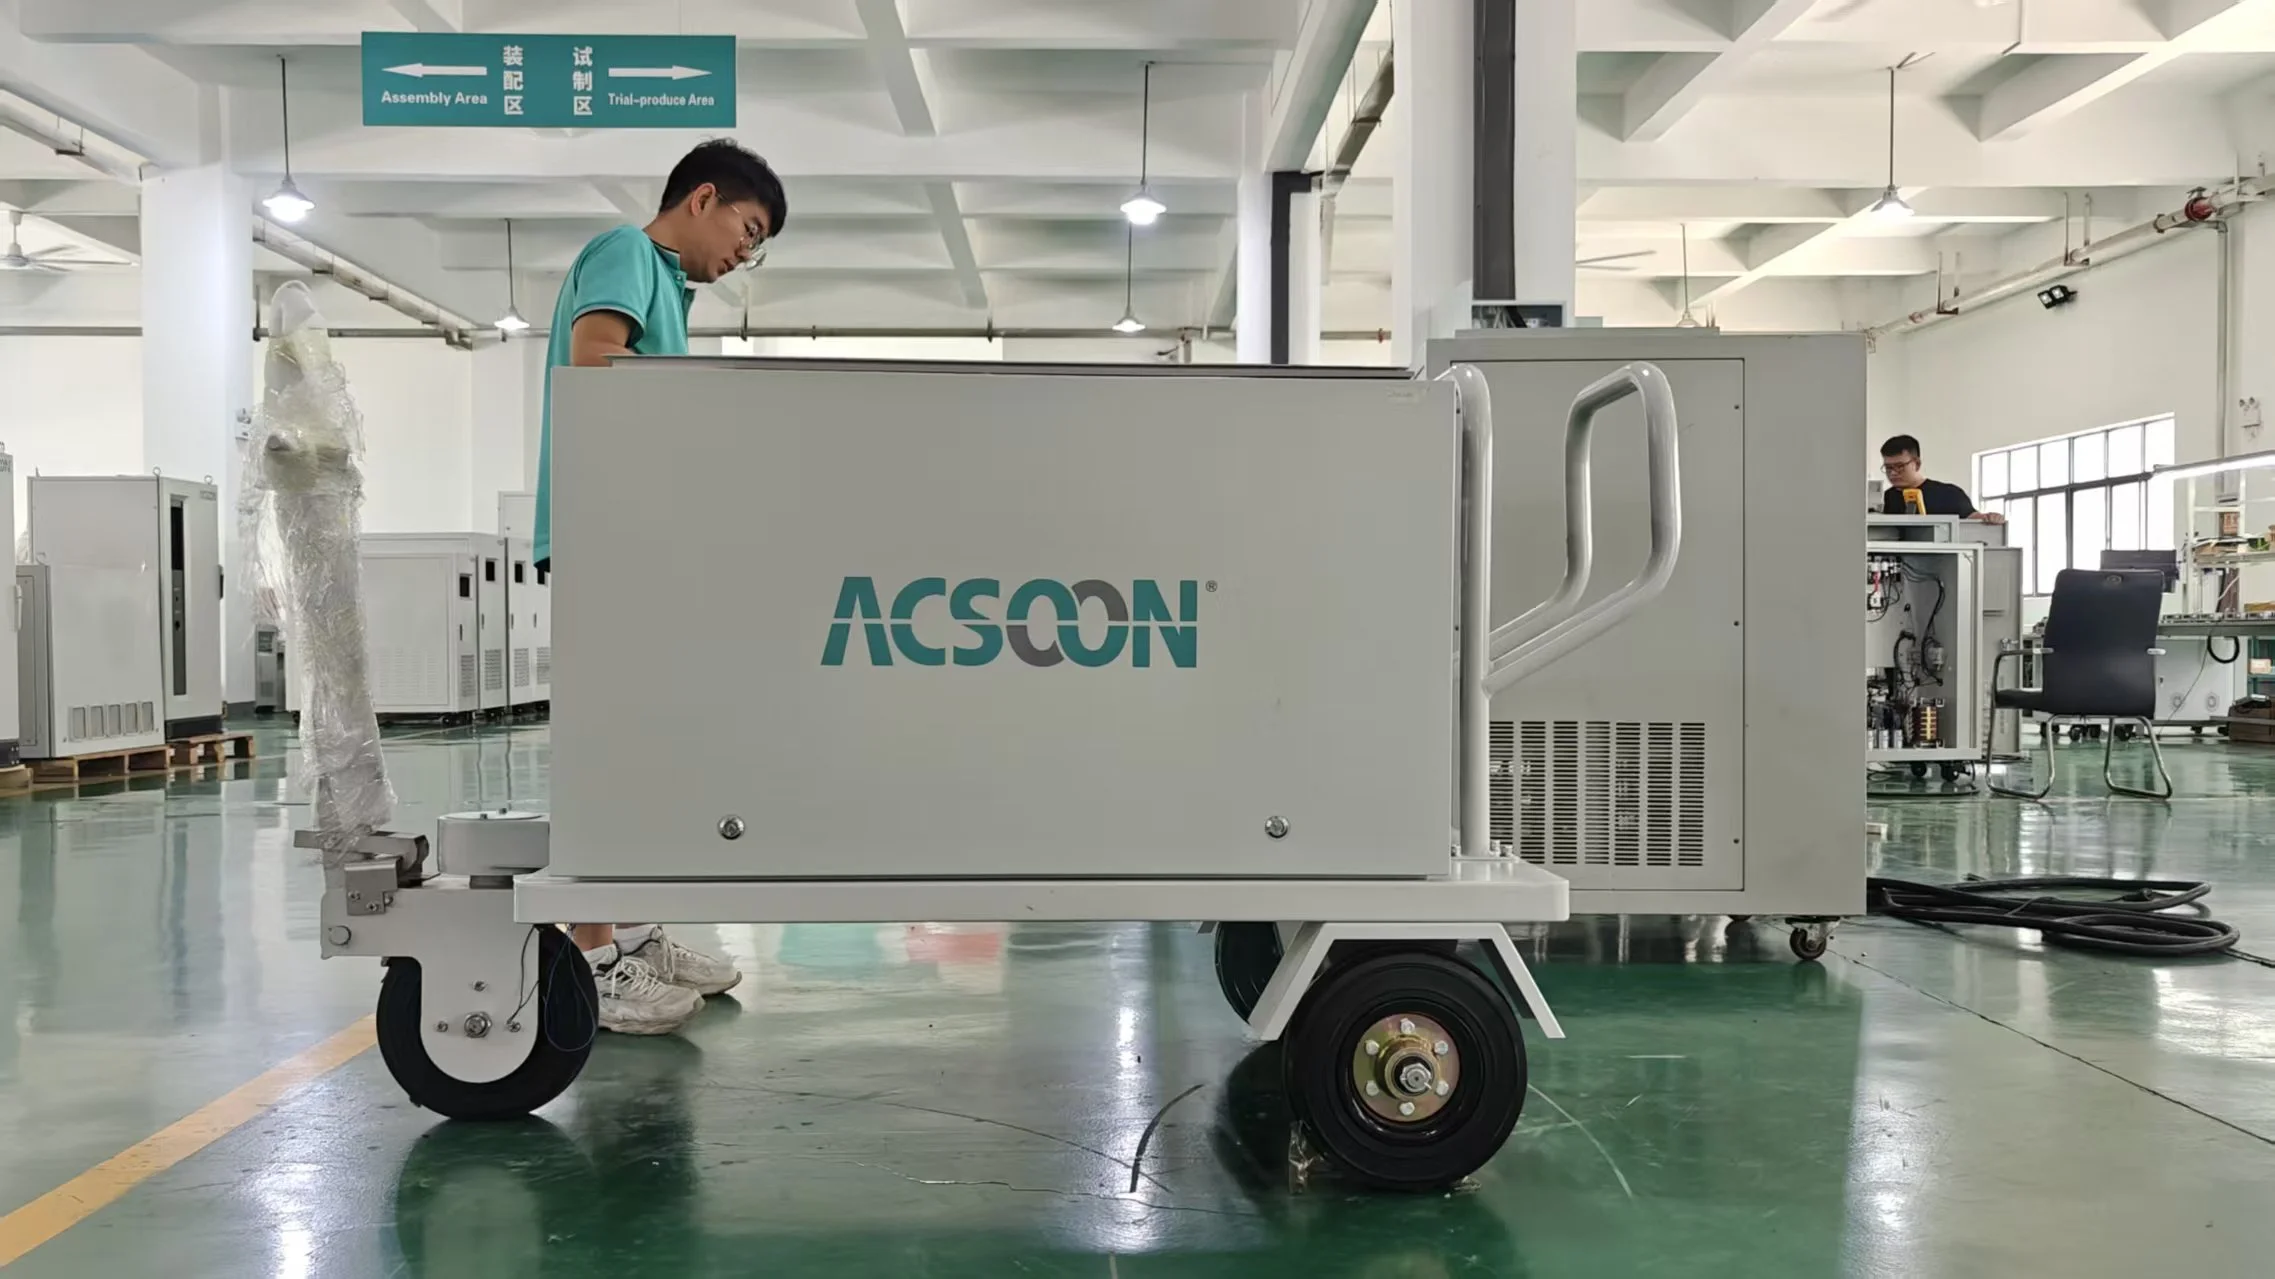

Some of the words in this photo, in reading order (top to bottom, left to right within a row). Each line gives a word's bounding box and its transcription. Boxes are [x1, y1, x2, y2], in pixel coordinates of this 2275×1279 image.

[381, 90, 452, 107] Assembly
[454, 91, 488, 105] Area
[503, 45, 524, 116] 装配区
[572, 46, 593, 116] 试制区
[608, 92, 686, 108] Trial-produce
[687, 93, 715, 106] Area
